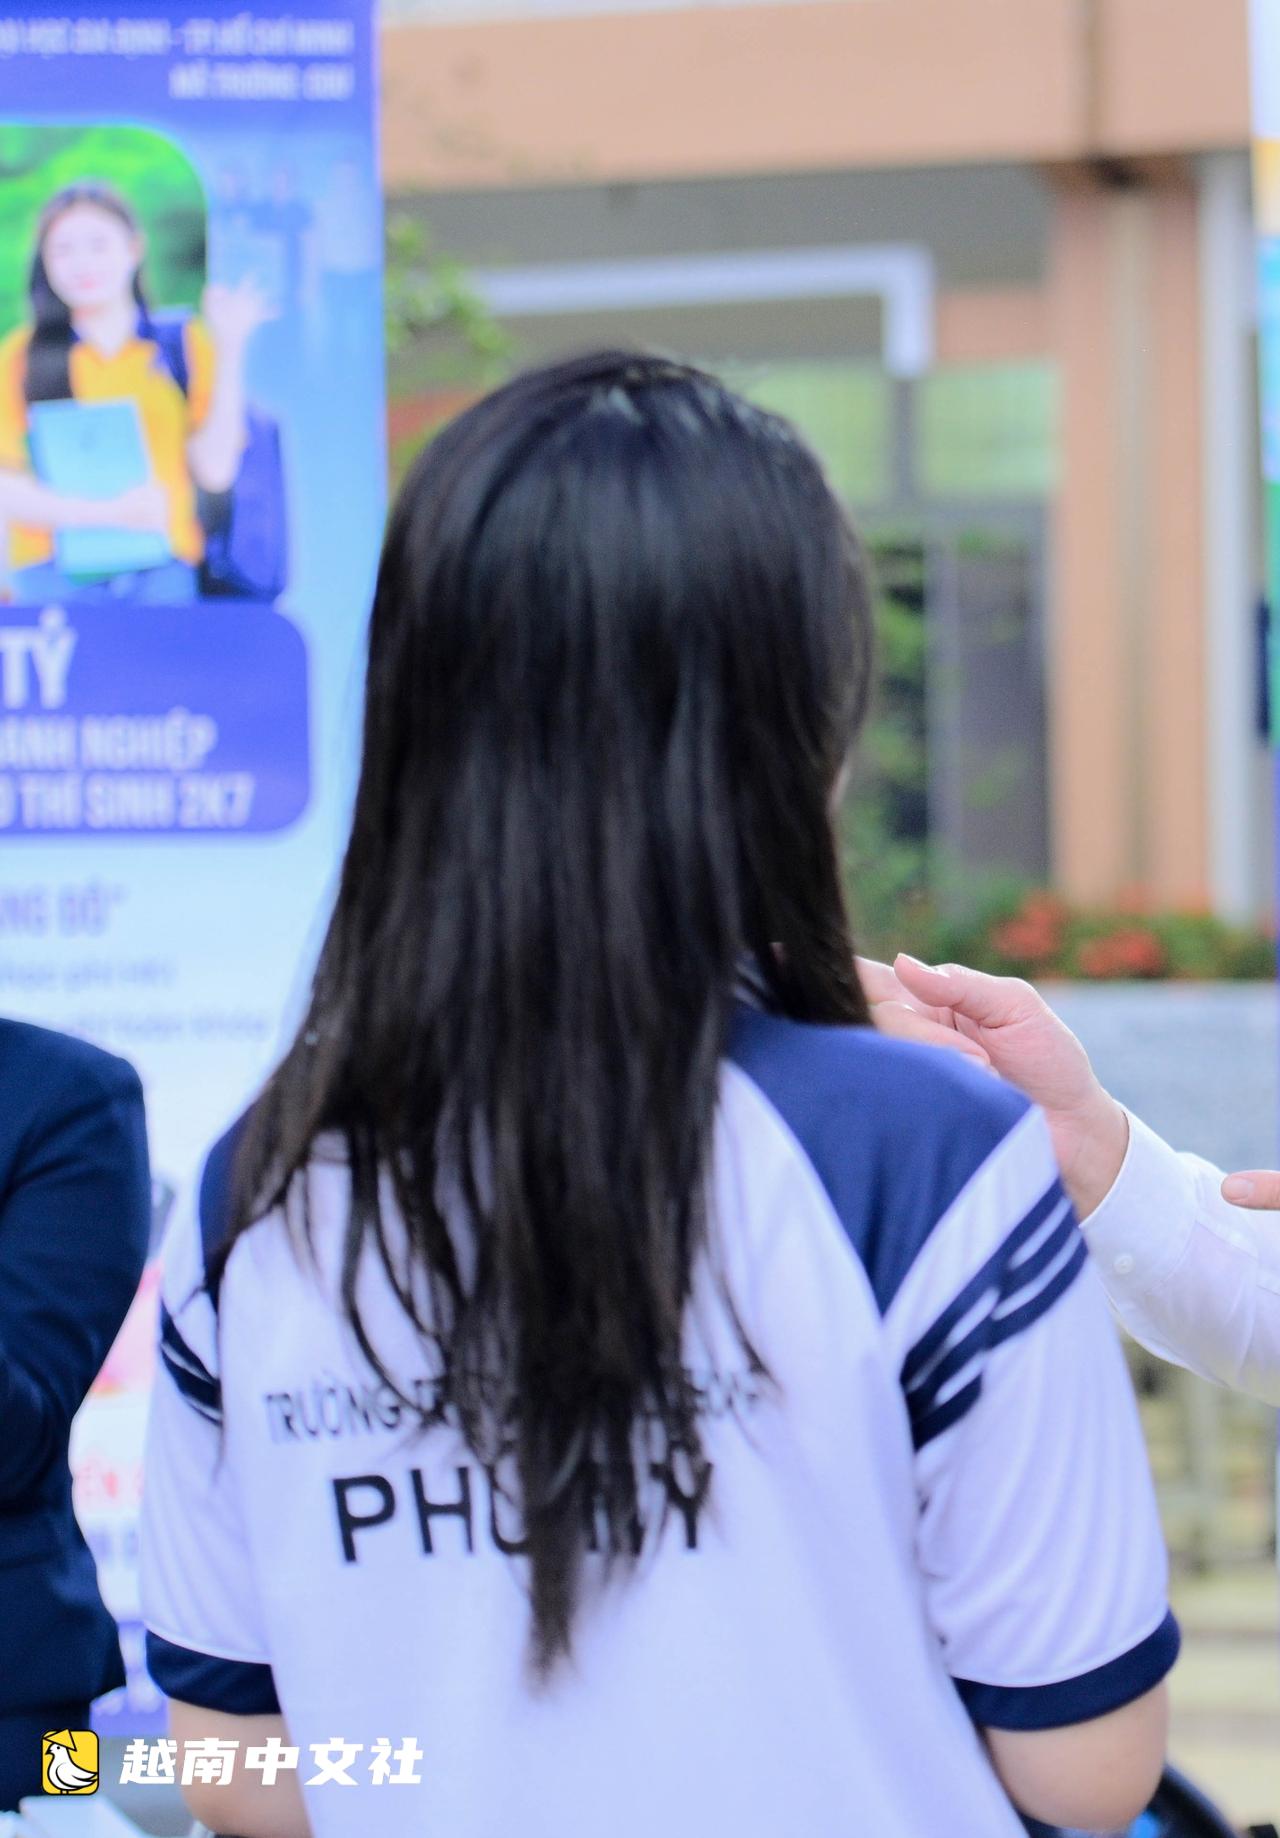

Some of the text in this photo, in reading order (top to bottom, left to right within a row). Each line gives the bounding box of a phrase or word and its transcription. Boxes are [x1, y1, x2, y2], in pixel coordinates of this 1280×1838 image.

[80, 705, 218, 772] NGHIỆP
[85, 771, 176, 828] SINH
[178, 771, 255, 828] 2K7
